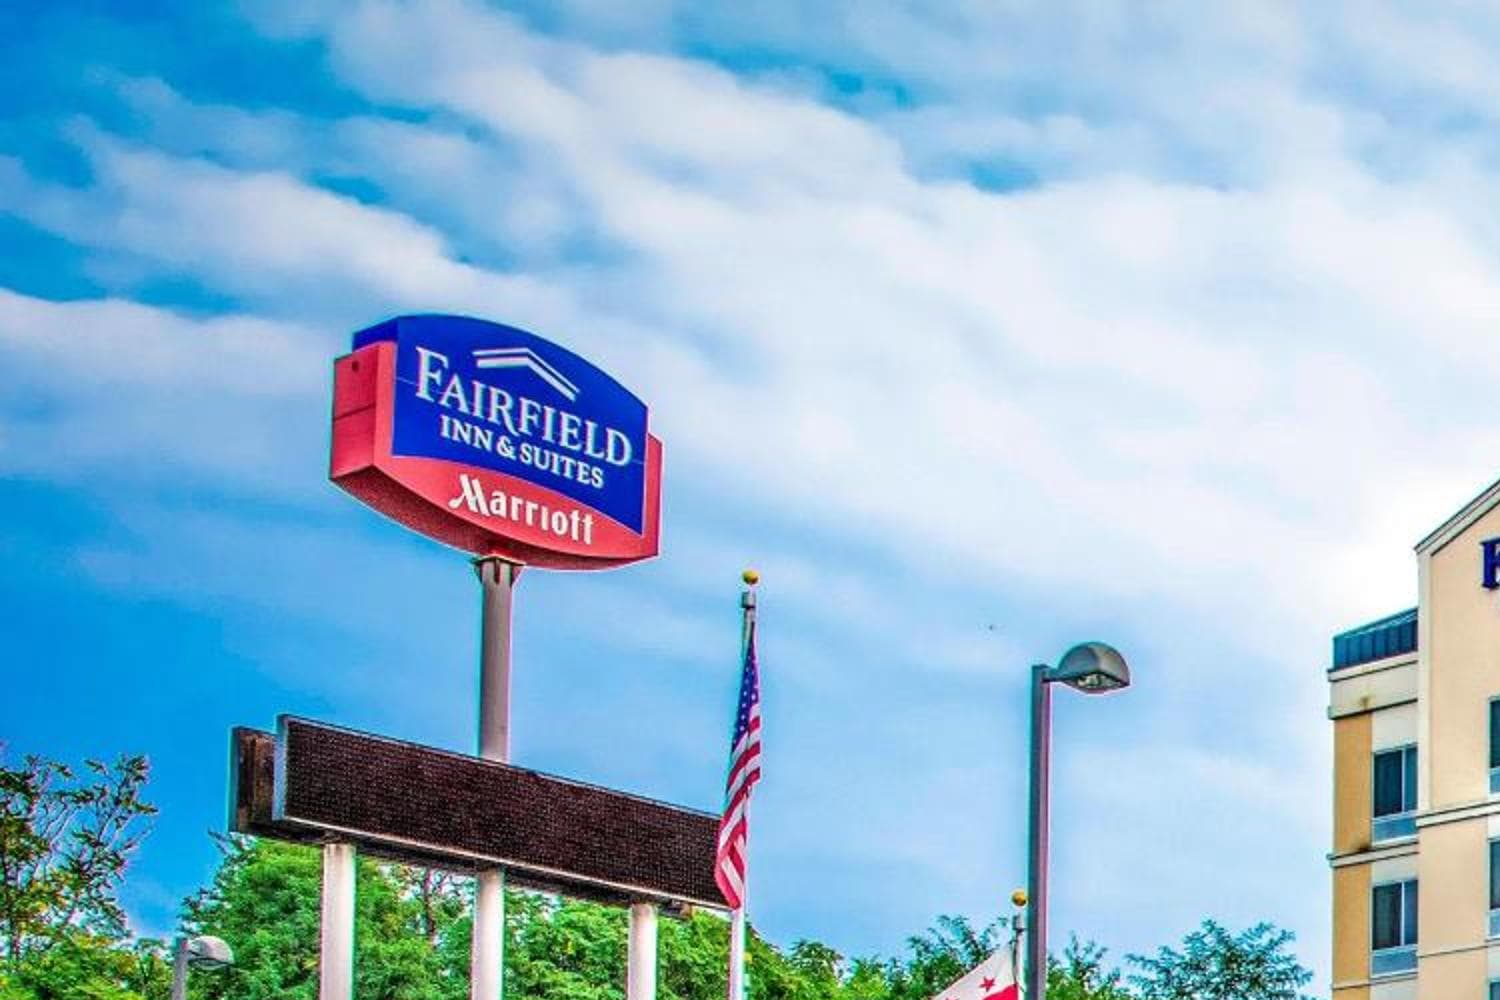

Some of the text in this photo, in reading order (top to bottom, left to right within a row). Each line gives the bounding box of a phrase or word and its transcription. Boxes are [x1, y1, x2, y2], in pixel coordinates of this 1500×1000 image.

[416, 346, 632, 466] FAIRFIELD
[440, 414, 493, 453] INN
[520, 441, 605, 489] SUITES
[449, 473, 595, 545] Marriott
